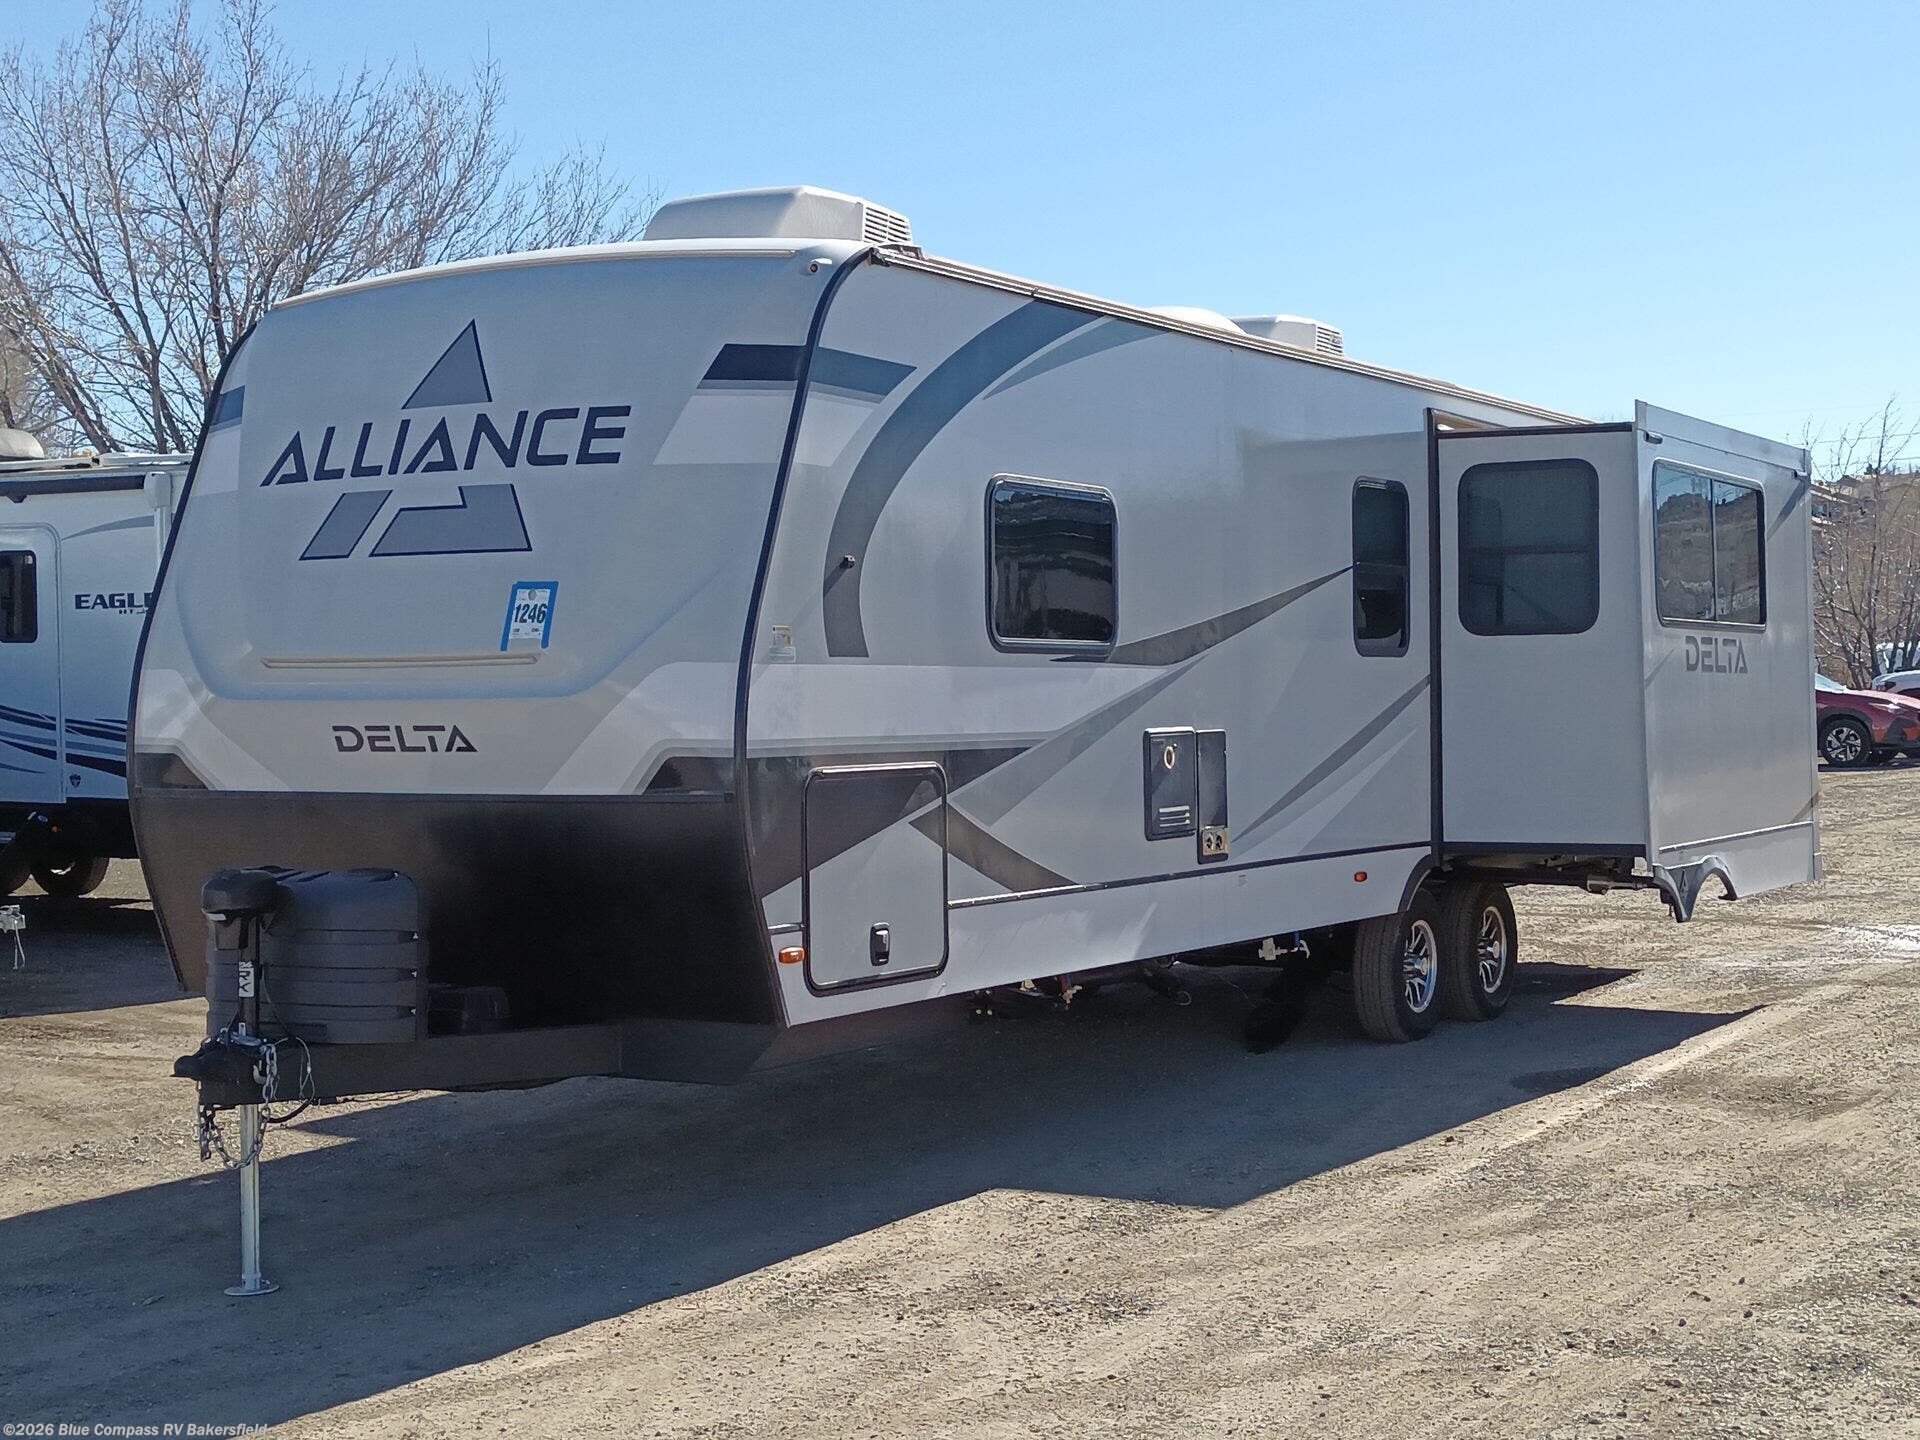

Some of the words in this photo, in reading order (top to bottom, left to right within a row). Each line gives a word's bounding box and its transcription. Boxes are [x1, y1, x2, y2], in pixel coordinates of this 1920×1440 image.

[260, 405, 631, 487] ALLIANCE
[514, 603, 548, 623] 1246
[1685, 635, 1748, 674] DELTA
[331, 725, 478, 752] DELTA
